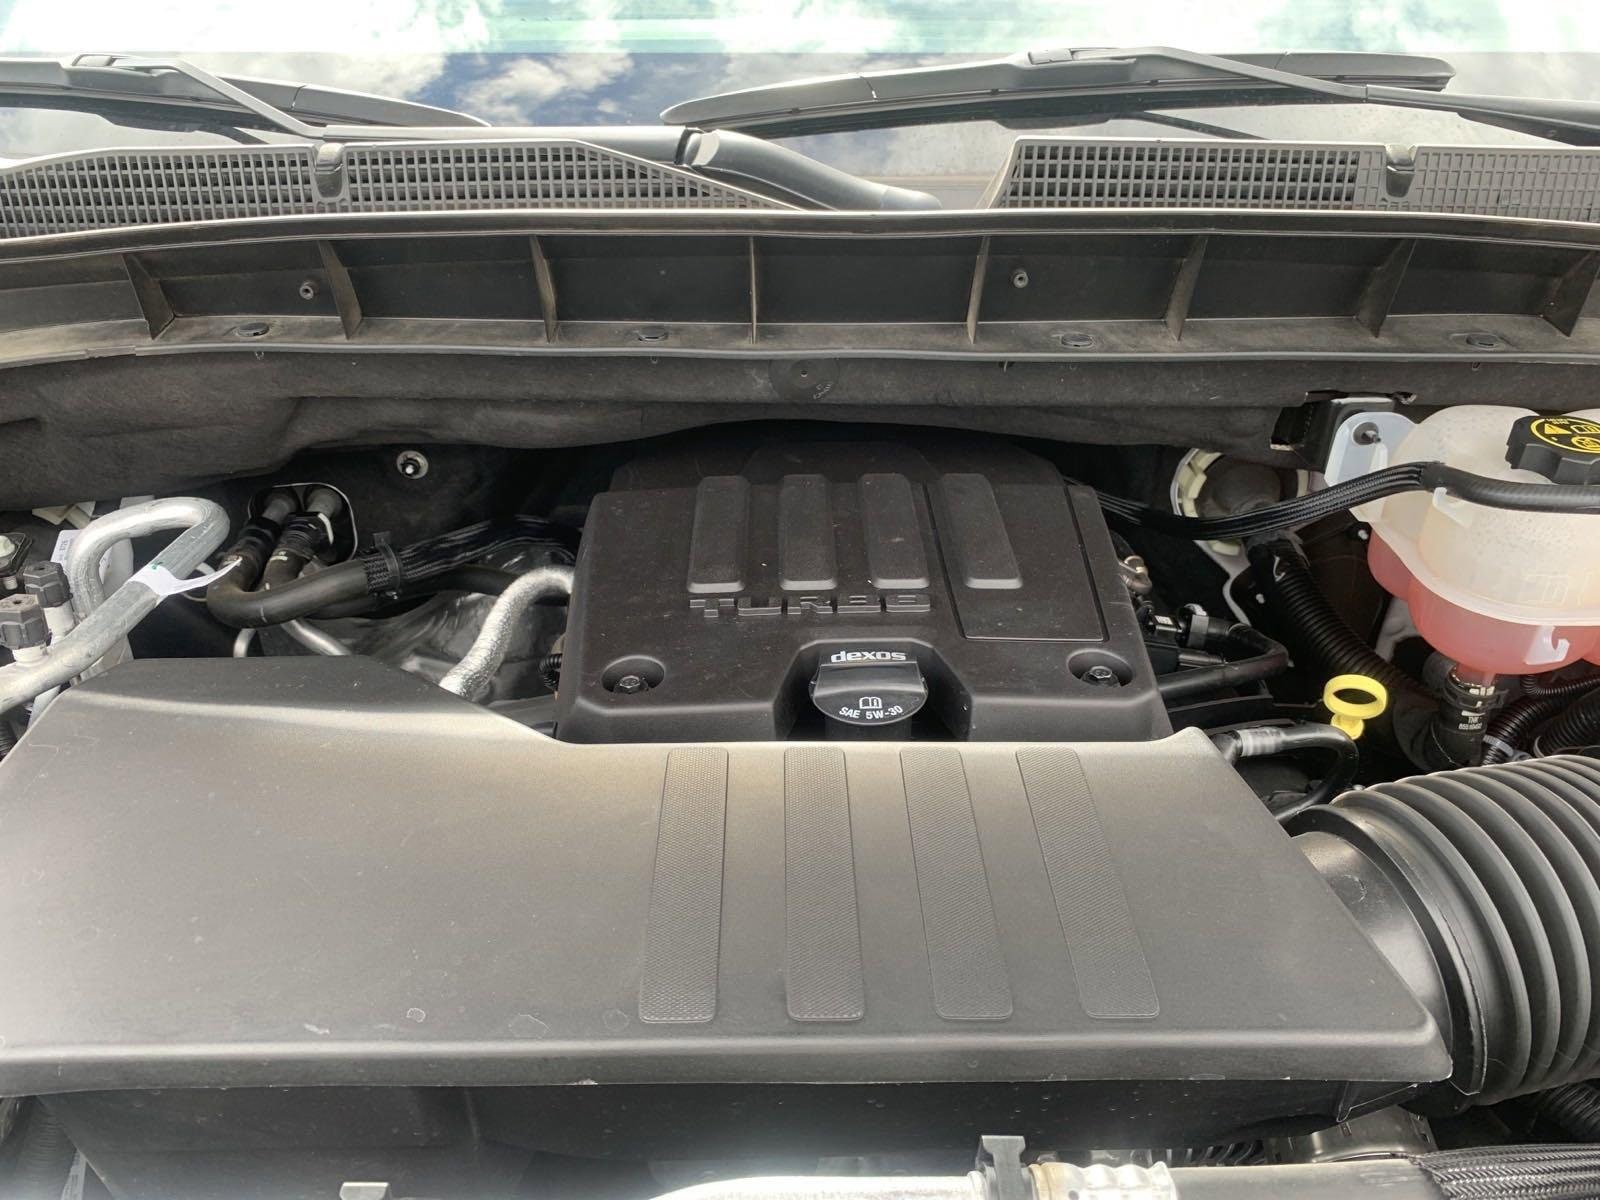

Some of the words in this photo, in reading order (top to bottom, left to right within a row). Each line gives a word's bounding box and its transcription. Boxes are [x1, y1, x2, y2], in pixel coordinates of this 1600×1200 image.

[689, 594, 931, 618] TURBO
[830, 650, 907, 662] dexos
[839, 706, 861, 719] SAE
[865, 705, 904, 720] 5W-30
